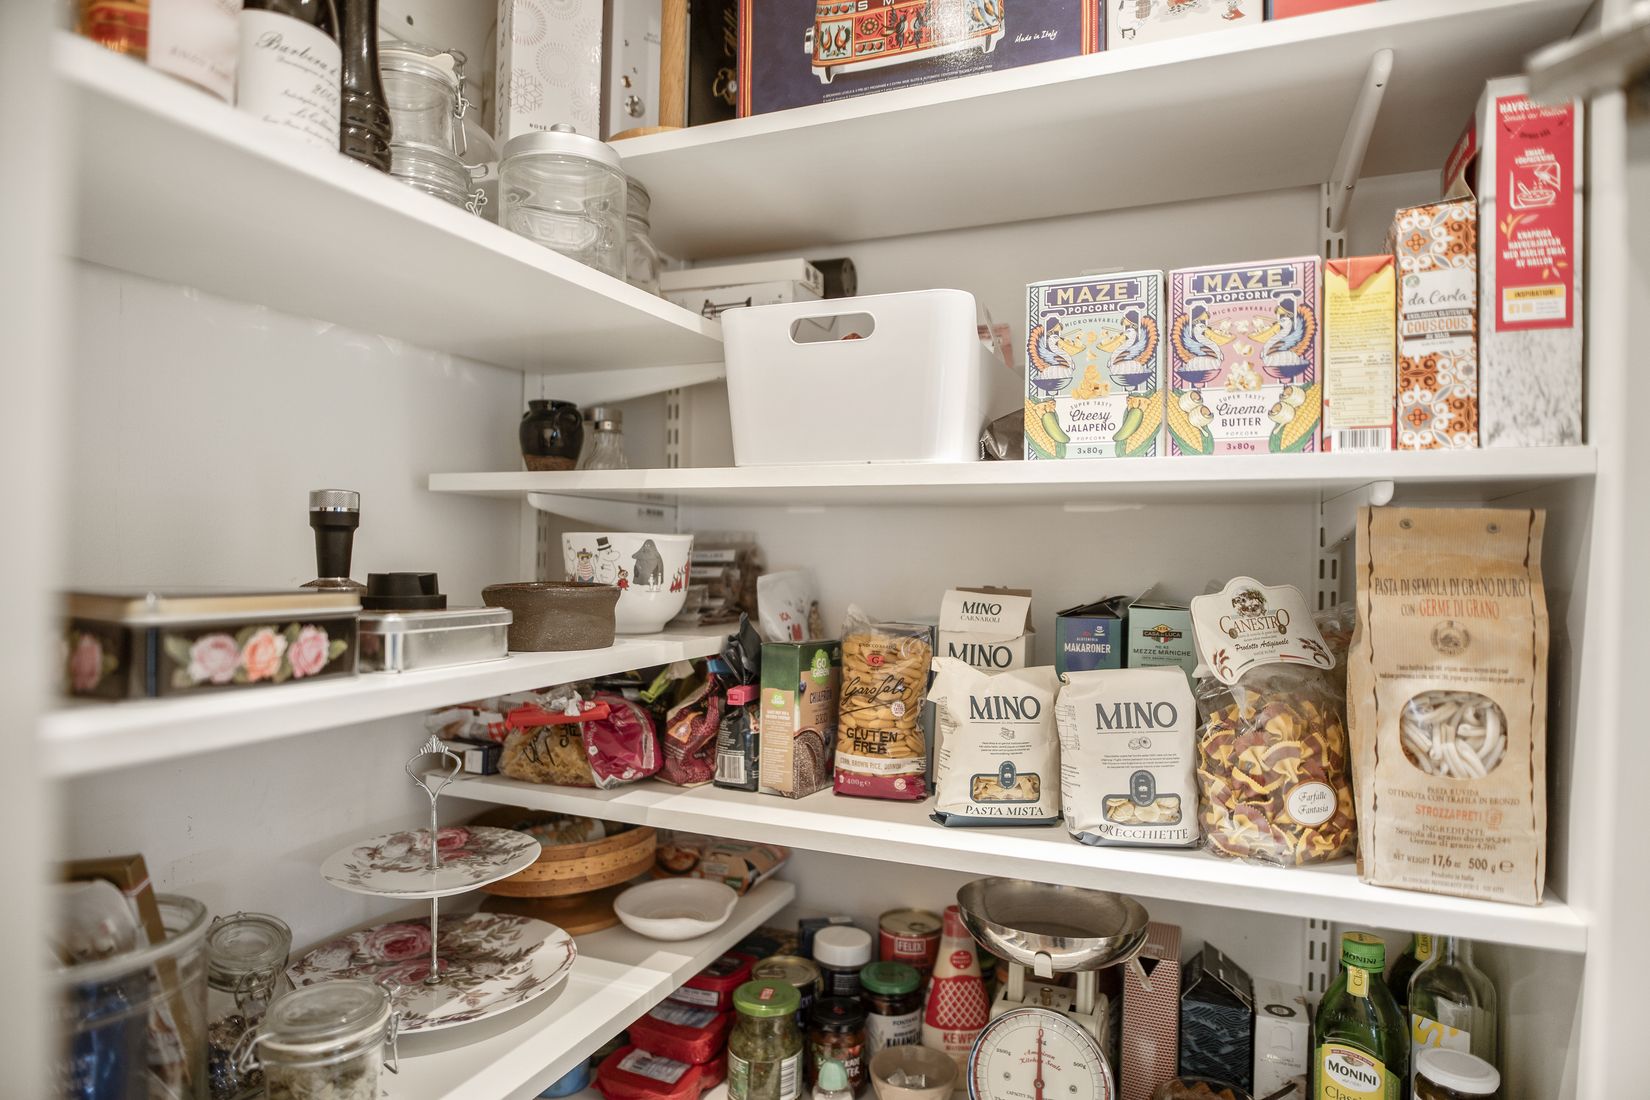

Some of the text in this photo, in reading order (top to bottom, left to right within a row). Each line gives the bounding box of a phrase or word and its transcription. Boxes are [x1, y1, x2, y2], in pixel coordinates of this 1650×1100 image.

[1015, 30, 1058, 43] Made in Italy
[1204, 269, 1283, 293] MAZE
[1057, 282, 1128, 305] MAZE
[1216, 291, 1268, 302] POPCORN
[1408, 288, 1467, 306] da Carla
[1068, 303, 1115, 314] POPCORN
[1212, 306, 1272, 316] MICROWAVABLE
[1065, 318, 1119, 327] MICROWAVABLE
[1407, 317, 1469, 333] COUSCOUS
[1071, 401, 1090, 410] SUPER
[1219, 394, 1241, 403] SUPER
[1069, 409, 1112, 423] Cheesy
[1216, 402, 1267, 416] Cinema
[1221, 417, 1261, 427] BUTTER
[1077, 447, 1103, 455] 3x80g
[1226, 443, 1255, 451] 3x80g
[1375, 577, 1526, 597] PASTA DI SEMOLA DI GRANO DURO
[961, 601, 1002, 616] MINO
[1401, 598, 1500, 619] CON GERME DI GRANO
[960, 615, 1000, 623] CARNAROLI
[1220, 609, 1290, 634] CANESTRO
[1064, 642, 1111, 654] MAKARONER
[1235, 638, 1289, 652] Prodotto Artigianale
[949, 642, 1012, 668] MINO
[816, 658, 826, 668] GO
[841, 674, 913, 706] Garofalo
[969, 695, 1041, 720] MINO
[1095, 701, 1178, 730] MINO
[846, 727, 898, 742] GLUTEN
[853, 740, 887, 754] FREE
[1298, 791, 1327, 803] Farfalle
[965, 805, 1044, 816] PASTA MISTA
[1298, 804, 1329, 814] Fantasia
[1415, 804, 1482, 822] STROZZAPRETI
[1099, 824, 1189, 839] ORECCHIETTE
[1432, 854, 1452, 869] 17,6
[1468, 858, 1488, 870] 500
[897, 940, 922, 951] FELIX
[1343, 950, 1377, 965] MONINI
[1328, 1060, 1377, 1086] MONINI
